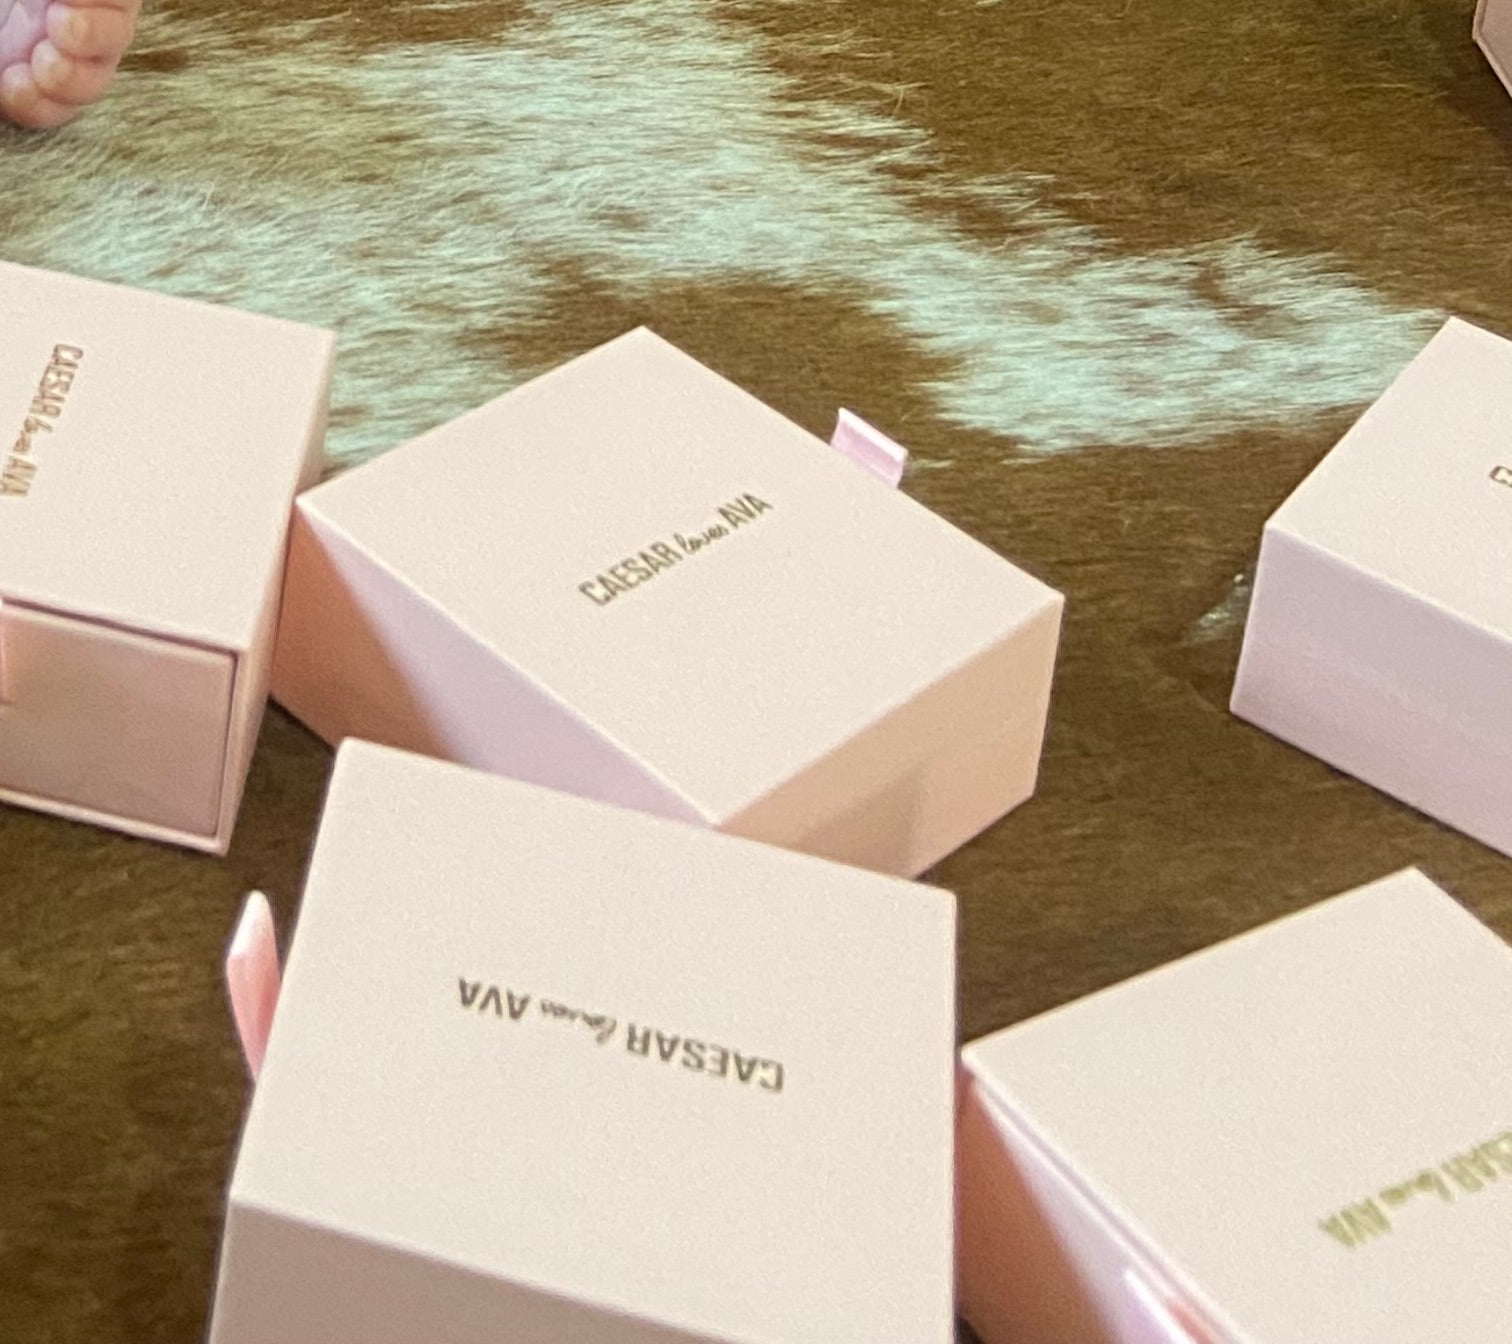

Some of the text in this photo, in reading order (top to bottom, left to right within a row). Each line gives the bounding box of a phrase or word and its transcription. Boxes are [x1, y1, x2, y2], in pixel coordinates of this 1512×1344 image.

[29, 343, 84, 417] CAESAR
[578, 492, 773, 607] CAESAR loves AVA
[458, 976, 530, 1021] AVA
[626, 1022, 784, 1093] CAESAR
[1317, 1196, 1391, 1248] AVA
